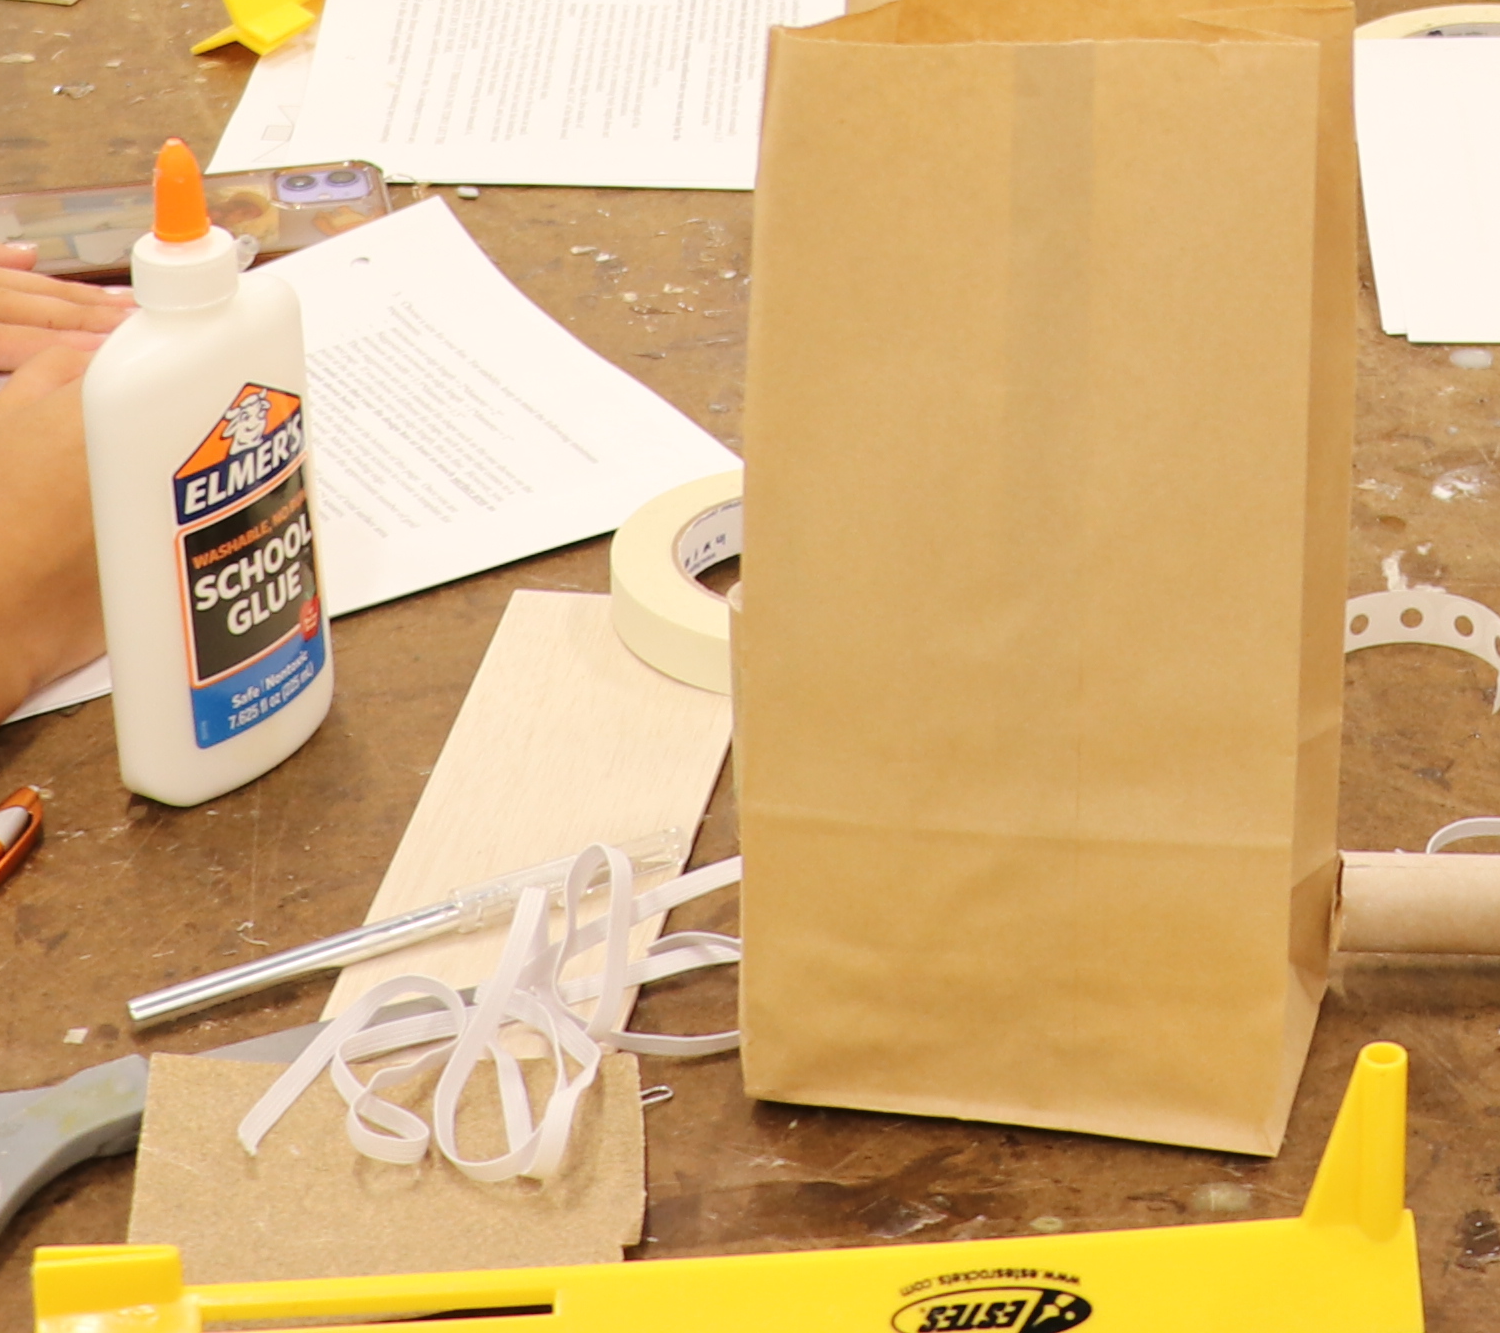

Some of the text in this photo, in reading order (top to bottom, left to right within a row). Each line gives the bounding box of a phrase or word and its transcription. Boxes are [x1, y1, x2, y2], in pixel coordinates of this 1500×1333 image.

[184, 413, 302, 516] ELMER'S
[191, 518, 273, 570] WASHABLE,
[194, 513, 312, 612] SCHOOL
[227, 561, 302, 636] GLUE
[231, 649, 309, 709] Safe Nontoxic
[228, 705, 260, 730] 7.625
[917, 1299, 1029, 1333] ESTES
